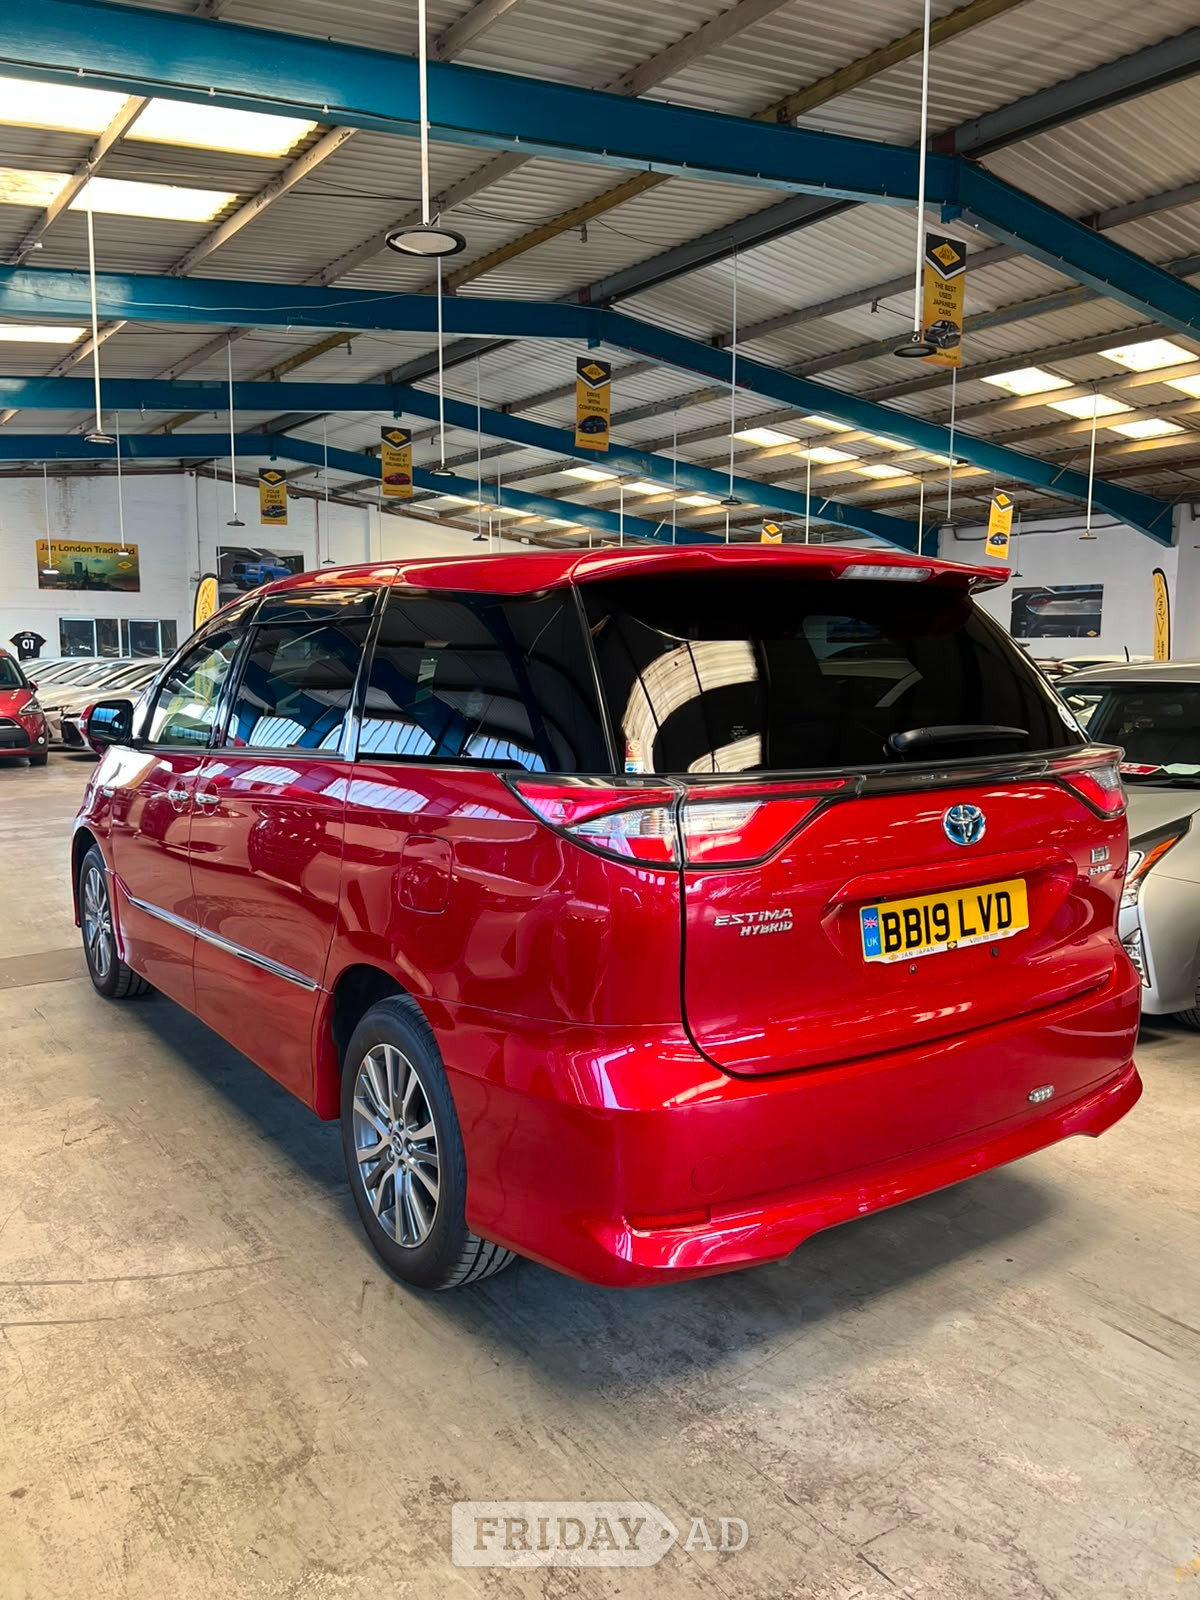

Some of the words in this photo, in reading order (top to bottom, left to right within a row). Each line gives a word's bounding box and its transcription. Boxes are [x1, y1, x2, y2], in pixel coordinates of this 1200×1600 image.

[934, 281, 944, 290] THE
[945, 284, 957, 293] BEST
[938, 291, 953, 300] USED
[932, 298, 957, 310] JAPANESE
[938, 307, 952, 317] CARS
[40, 543, 56, 551] Jan
[58, 543, 92, 553] London
[22, 638, 35, 650] 01
[713, 907, 793, 927] ESTIMA
[881, 902, 951, 953] BB19
[957, 891, 1012, 938] LVD
[740, 920, 793, 936] HYBRID
[866, 937, 879, 948] UK
[901, 951, 913, 959] JAN
[917, 946, 935, 956] JAPAN
